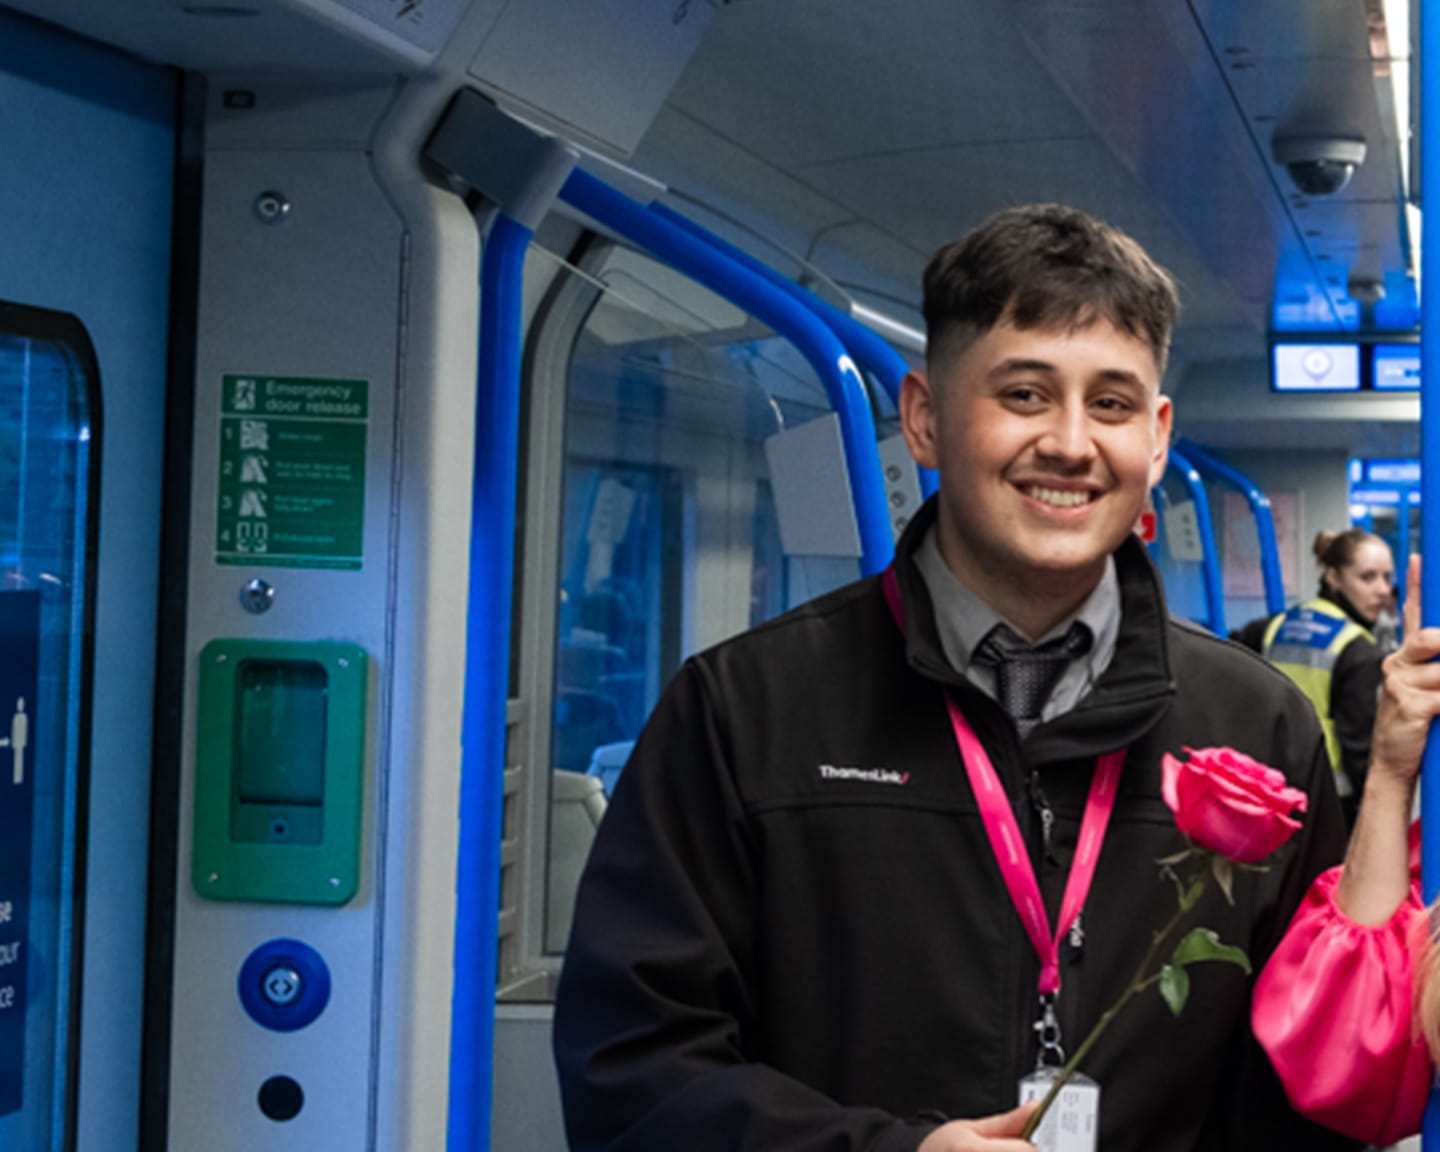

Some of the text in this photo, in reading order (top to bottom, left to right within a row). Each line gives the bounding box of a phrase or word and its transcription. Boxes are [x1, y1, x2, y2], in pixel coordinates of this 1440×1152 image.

[265, 380, 352, 400] Emergency
[265, 399, 361, 415] door release
[225, 427, 232, 440] 1
[223, 461, 233, 475] 2
[221, 495, 232, 510] 3
[220, 529, 231, 543] 4
